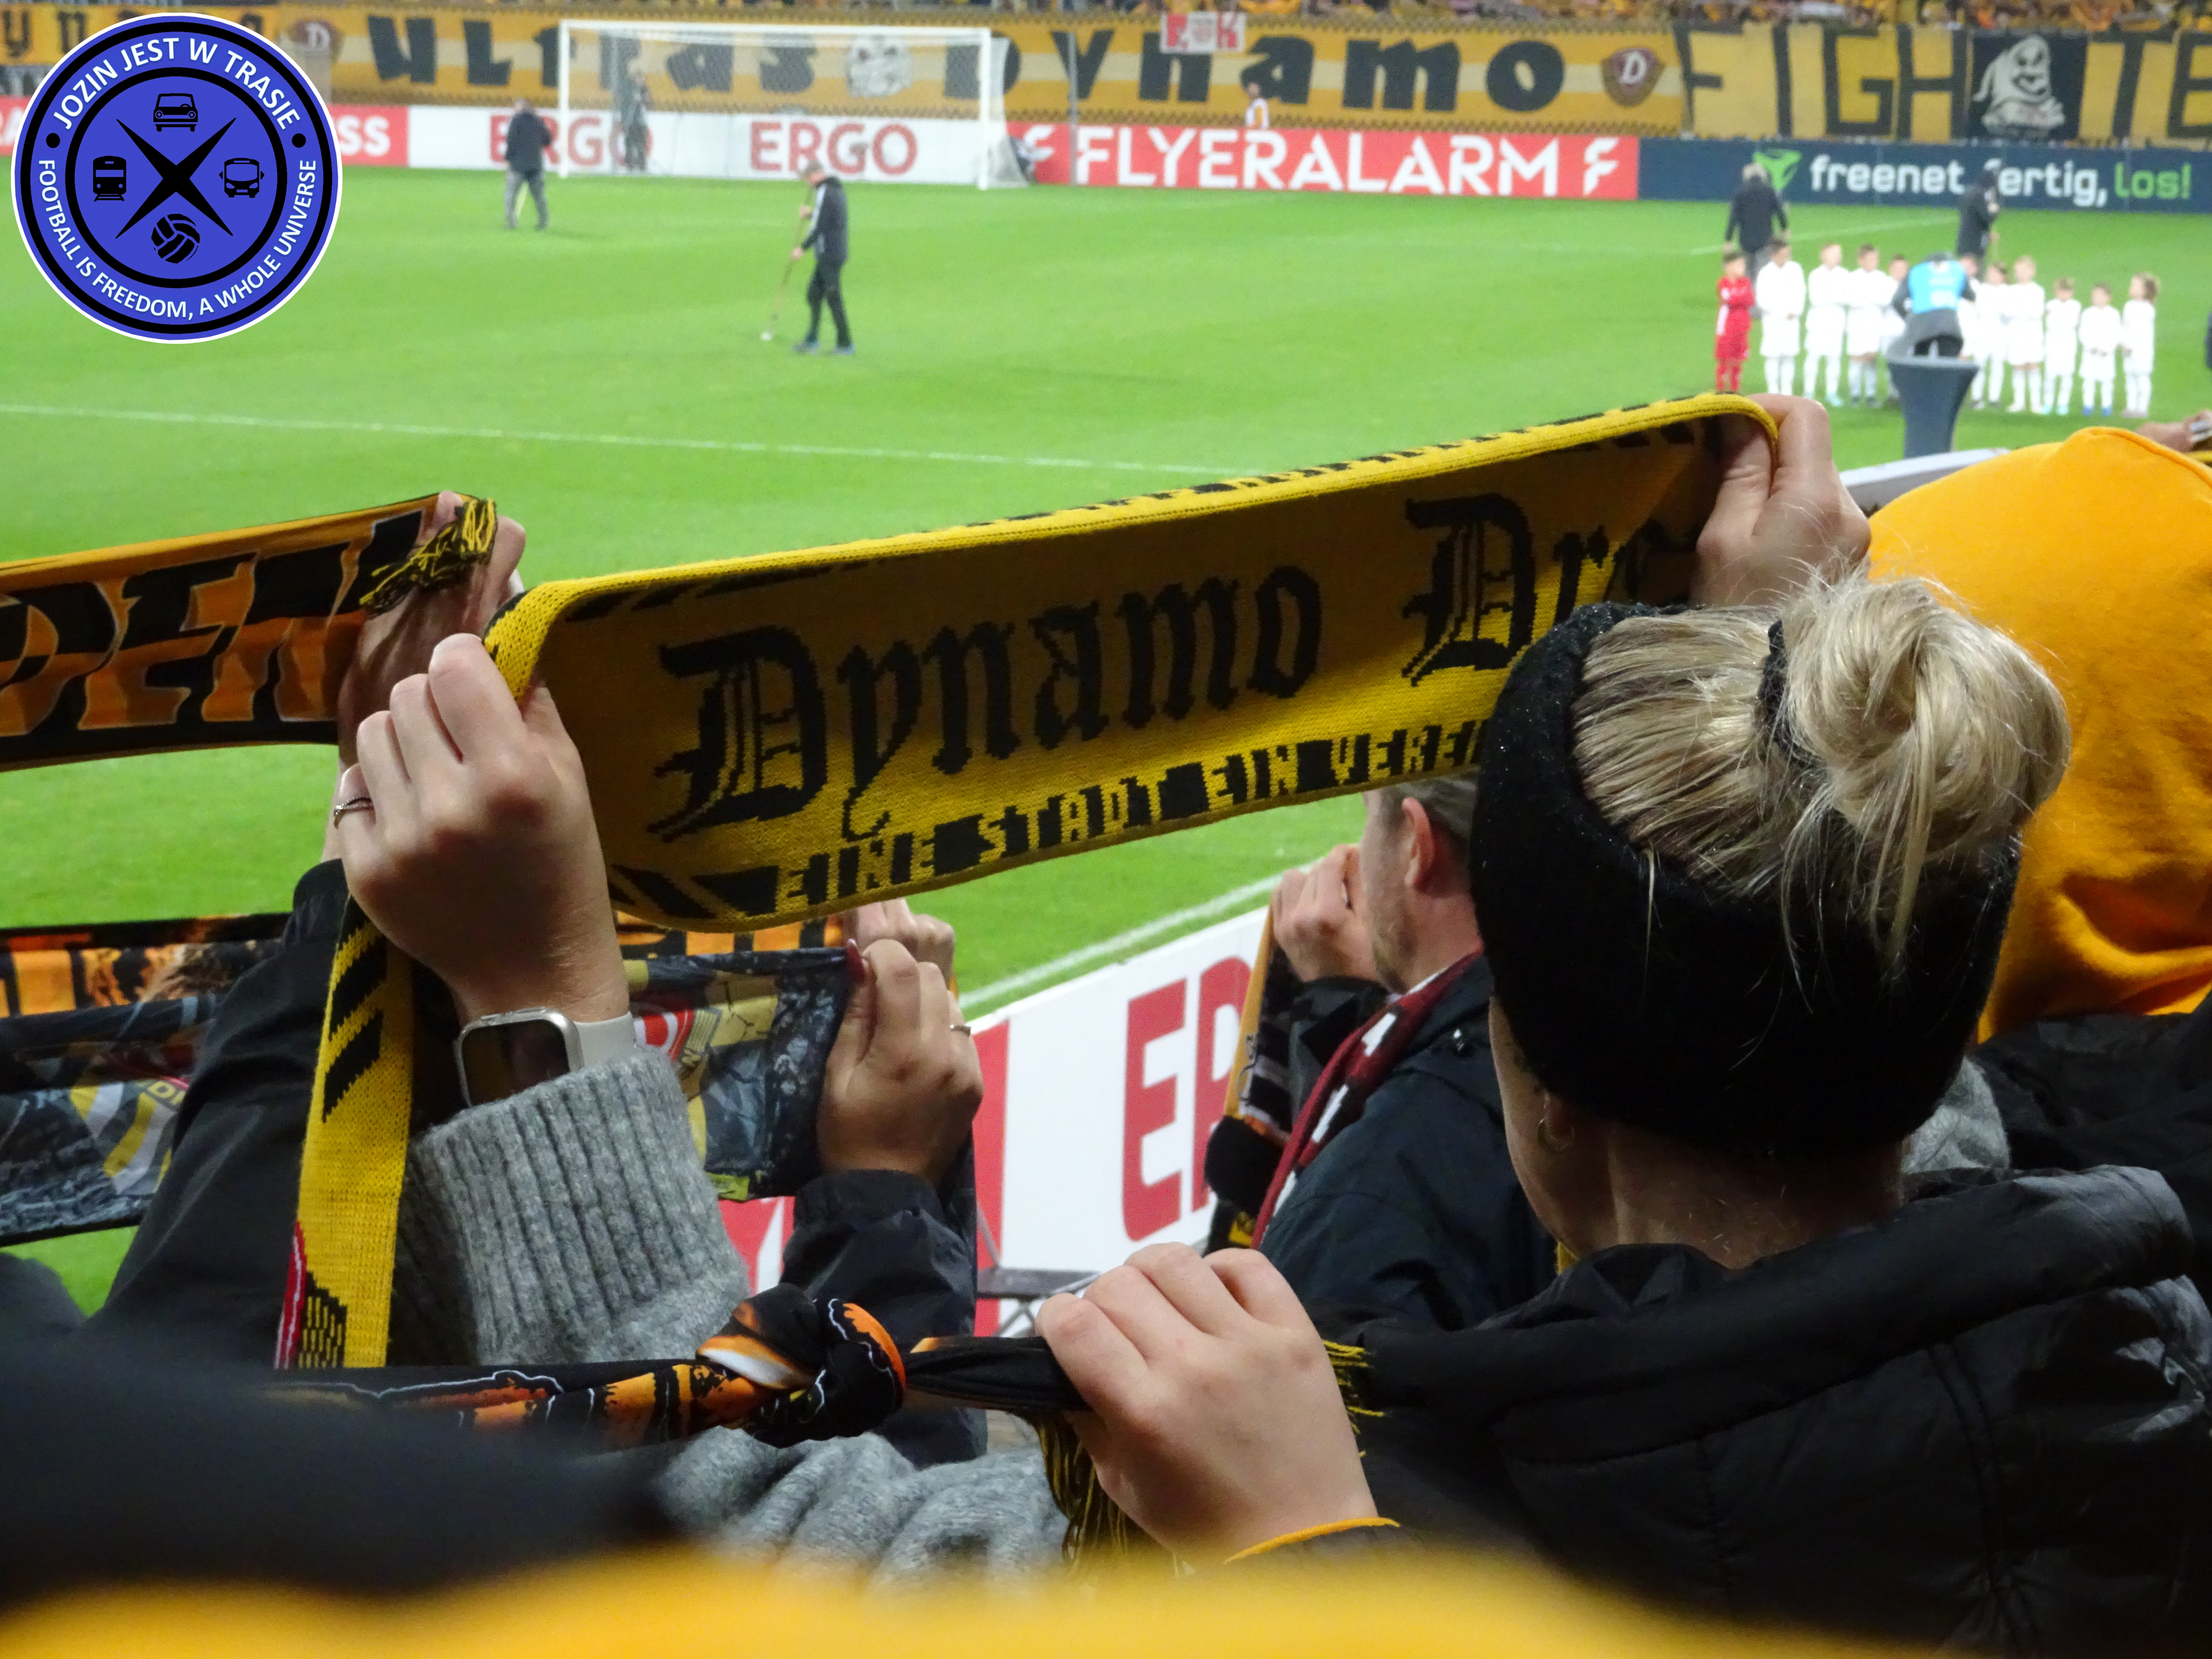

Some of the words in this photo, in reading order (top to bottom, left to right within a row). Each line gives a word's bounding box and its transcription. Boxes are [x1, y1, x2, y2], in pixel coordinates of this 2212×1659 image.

[750, 121, 917, 175] ERGO
[1076, 127, 1559, 196] FLYERALARM
[1809, 154, 1965, 194] freenet
[2114, 162, 2191, 199] los!
[646, 565, 1322, 841] Dynamo
[774, 831, 935, 915] EINE
[977, 770, 1170, 865] STADT
[1200, 747, 1300, 813] EIN
[1330, 720, 1482, 785] VEREI
[1122, 956, 1254, 1242] ER
